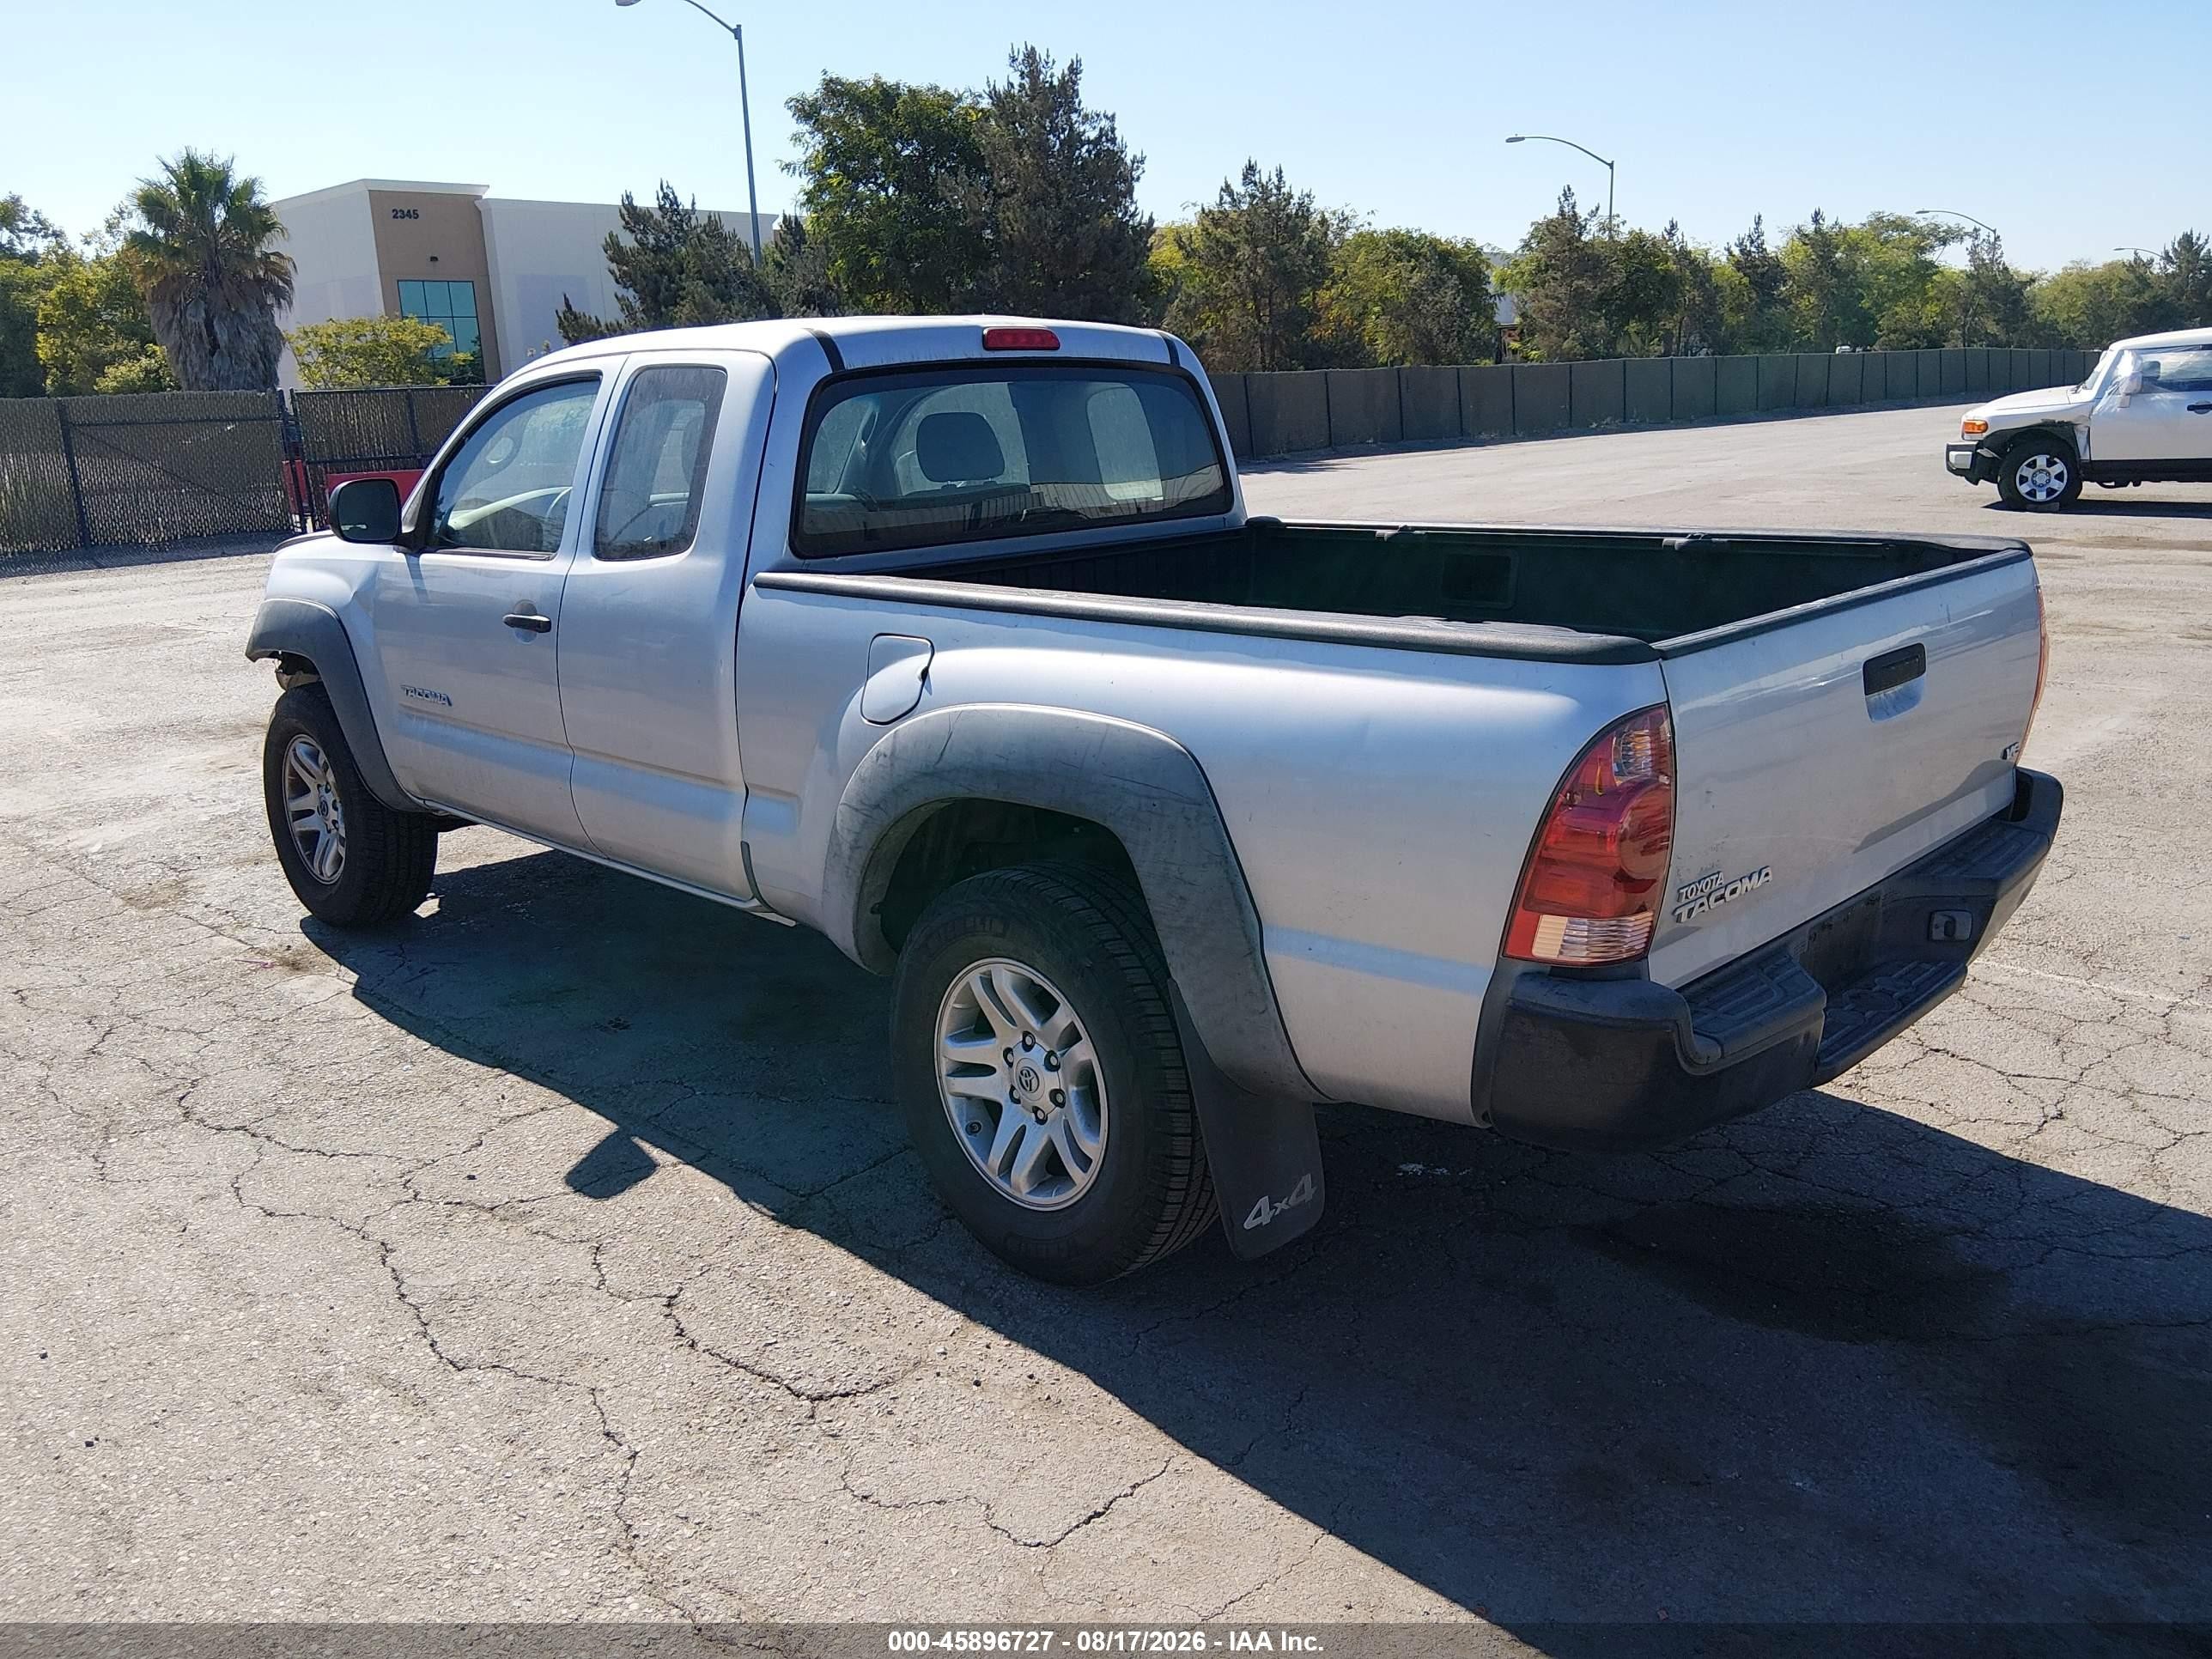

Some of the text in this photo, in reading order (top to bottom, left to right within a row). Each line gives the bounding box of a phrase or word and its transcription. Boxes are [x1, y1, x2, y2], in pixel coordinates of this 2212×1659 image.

[392, 208, 419, 220] 2345
[401, 684, 452, 706] TACOMA
[1672, 866, 1772, 923] TACOMA
[1677, 871, 1724, 902] TOYOTA
[1243, 1173, 1316, 1230] 4x4
